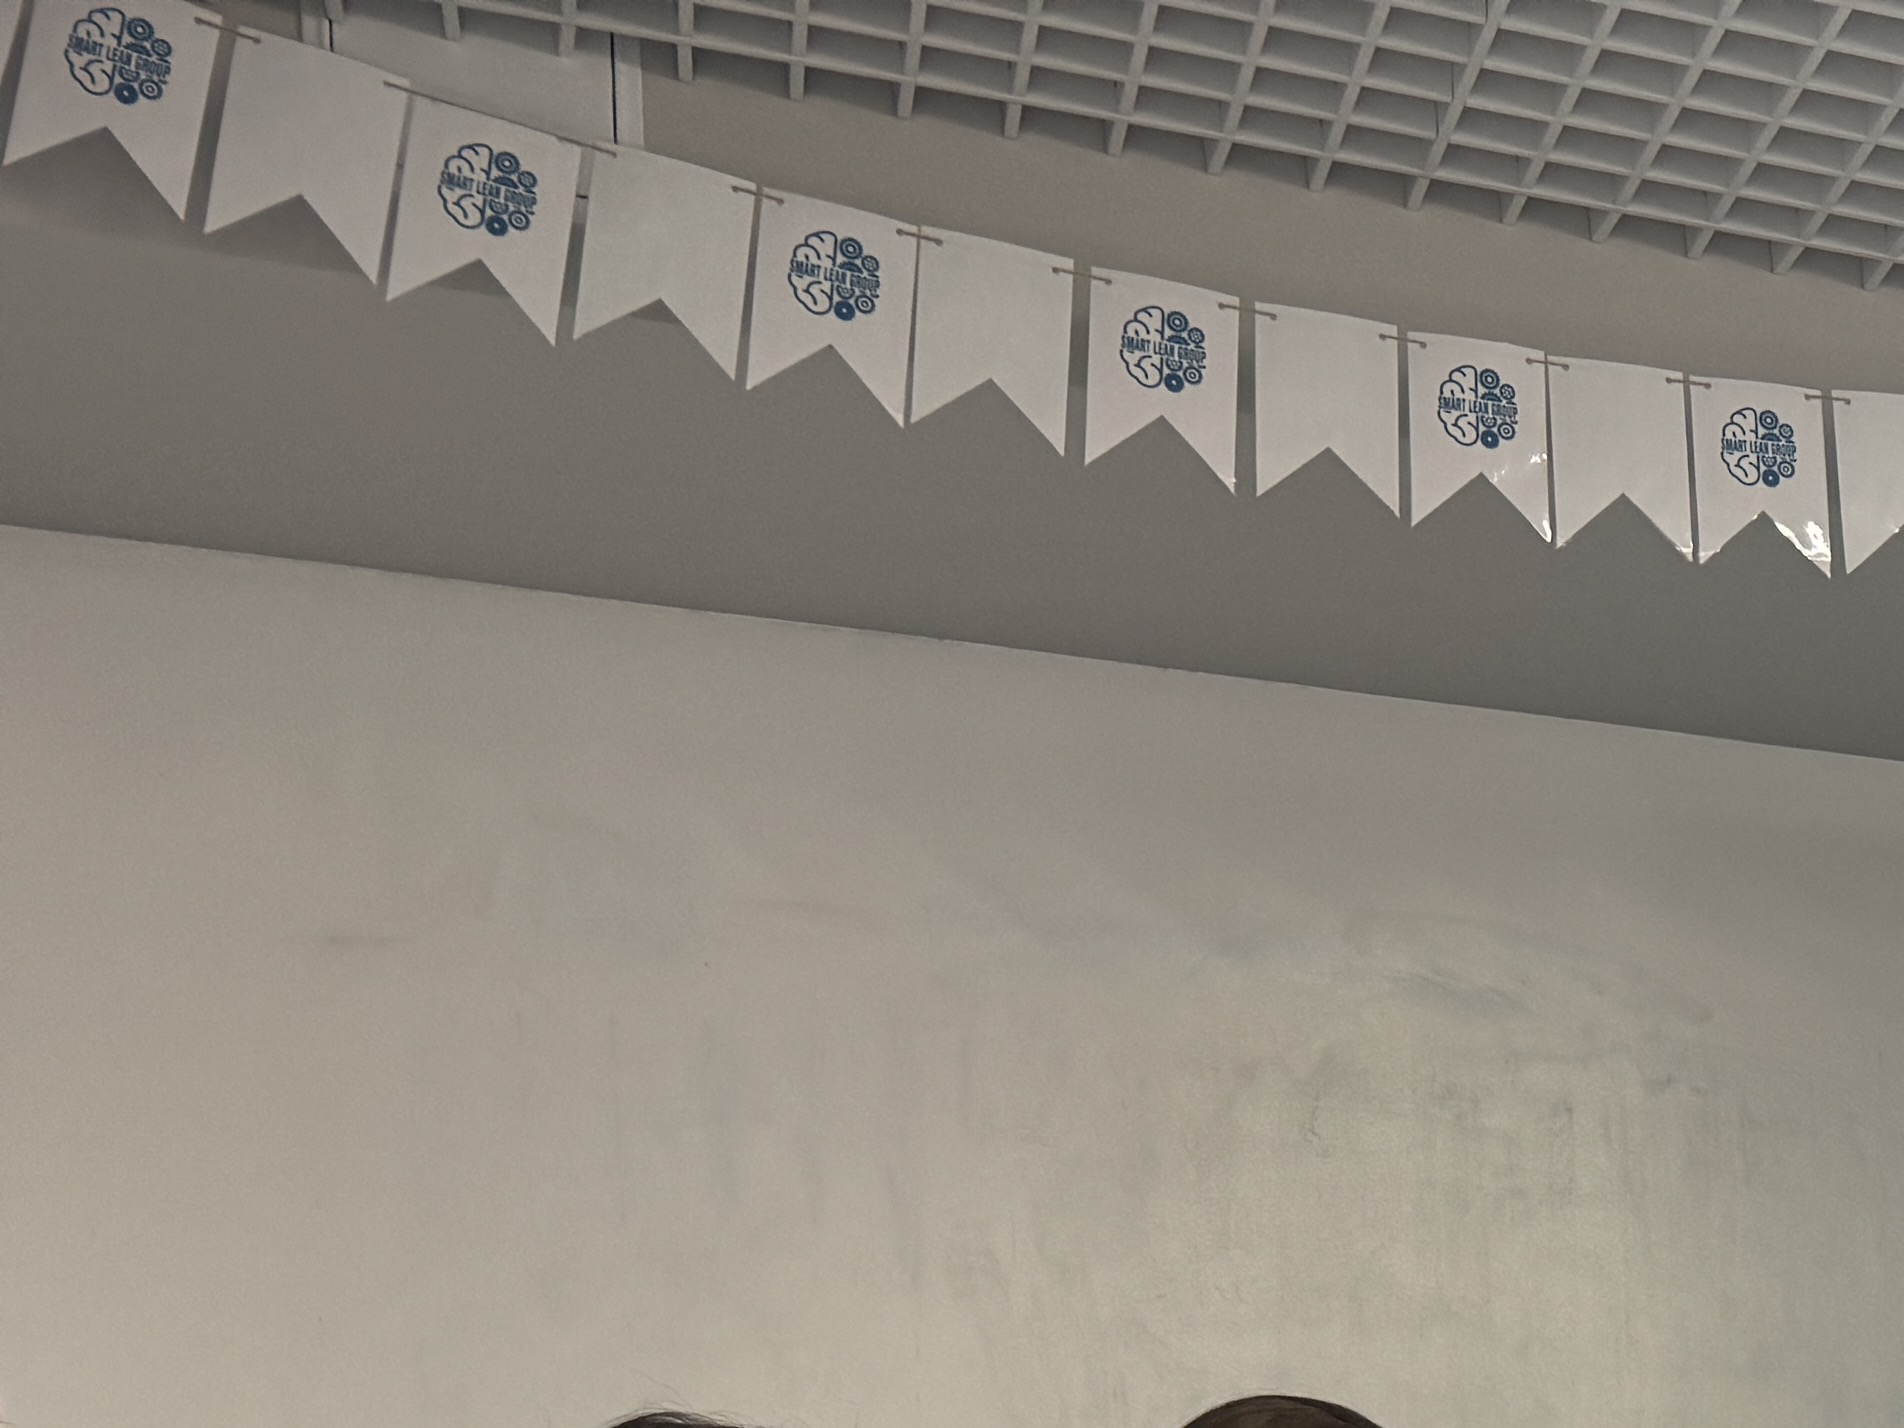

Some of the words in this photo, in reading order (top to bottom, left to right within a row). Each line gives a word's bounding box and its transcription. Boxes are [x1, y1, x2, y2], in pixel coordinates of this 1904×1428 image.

[68, 35, 104, 57] SMART
[106, 45, 132, 68] LEAN
[134, 53, 171, 78] GROUP
[442, 170, 473, 191] SMART
[476, 179, 499, 198] LEAN
[503, 188, 537, 208] GROUP
[791, 260, 820, 278] SMART
[823, 268, 847, 284] LEAN
[850, 275, 880, 291] GROUP
[1122, 335, 1150, 353] SMART
[1153, 341, 1175, 356] LEAN
[1178, 346, 1207, 361] GROUP
[1438, 397, 1466, 412] SMART
[1468, 398, 1489, 413] LEAN
[1492, 402, 1518, 418] GROUP
[1721, 439, 1747, 453] SMART
[1750, 439, 1769, 453] LEAN
[1771, 441, 1796, 456] GROUP
